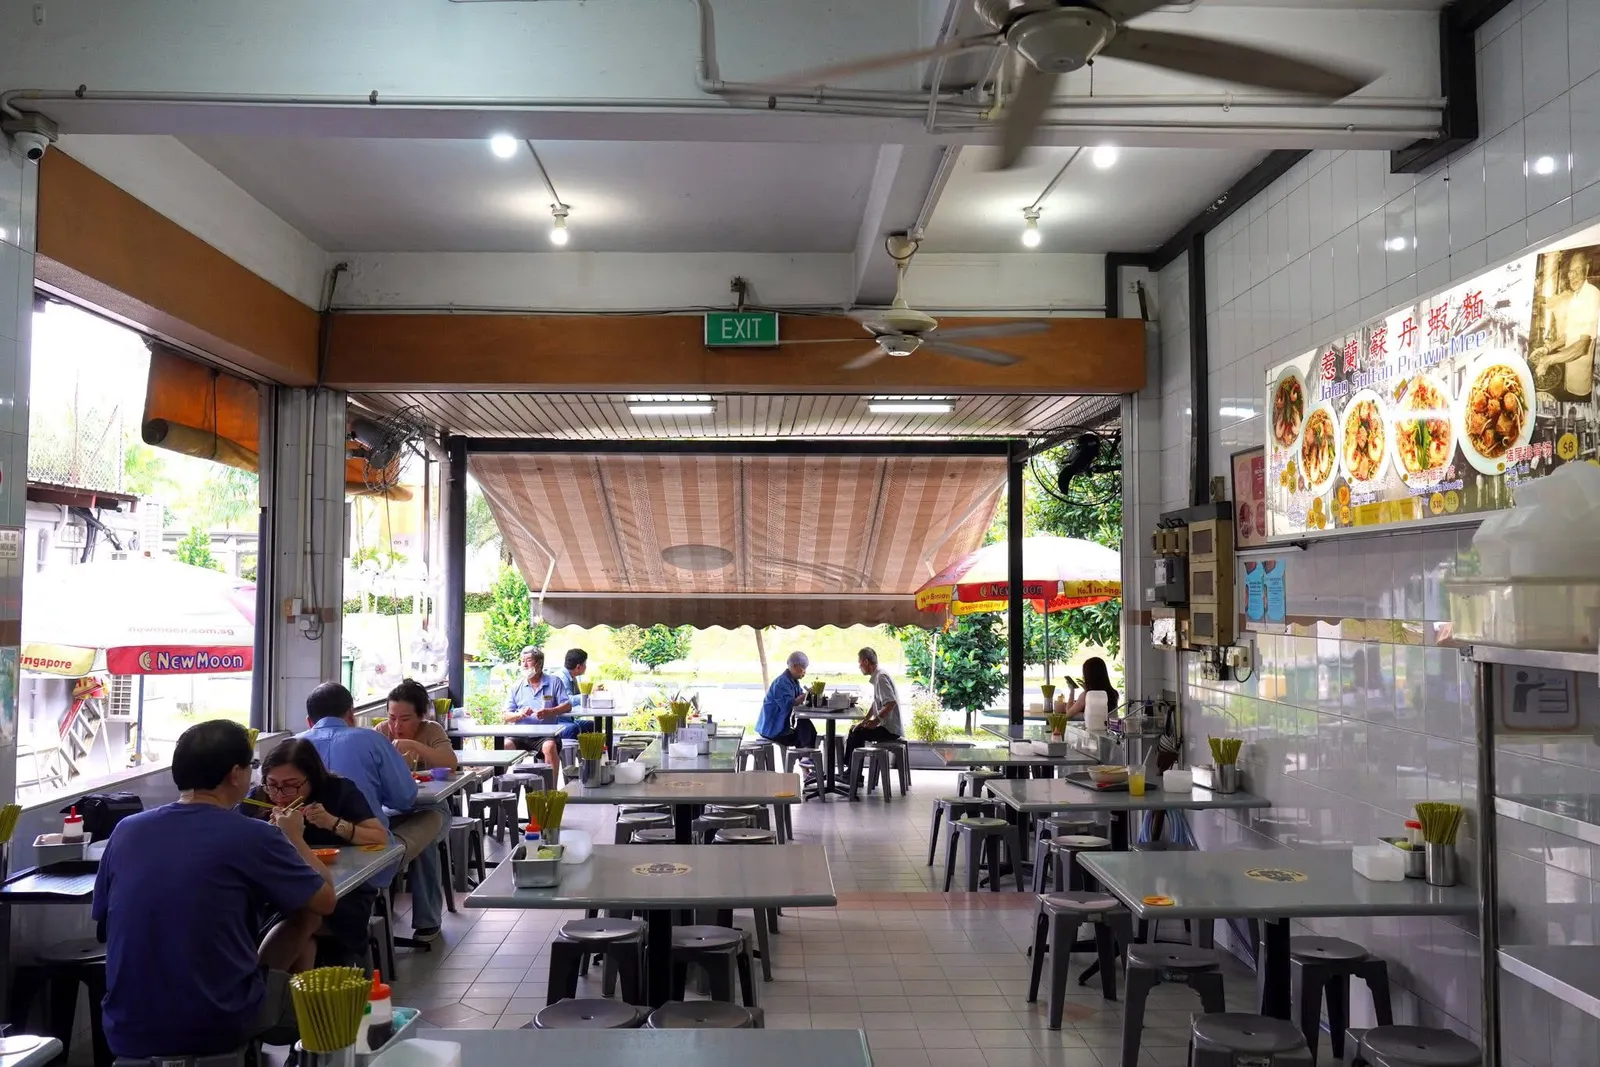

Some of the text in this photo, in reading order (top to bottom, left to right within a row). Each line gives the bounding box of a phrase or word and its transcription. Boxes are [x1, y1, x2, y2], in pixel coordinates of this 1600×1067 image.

[722, 318, 762, 339] EXIT
[1321, 330, 1487, 401] Jalan Sultan Prawn Mee
